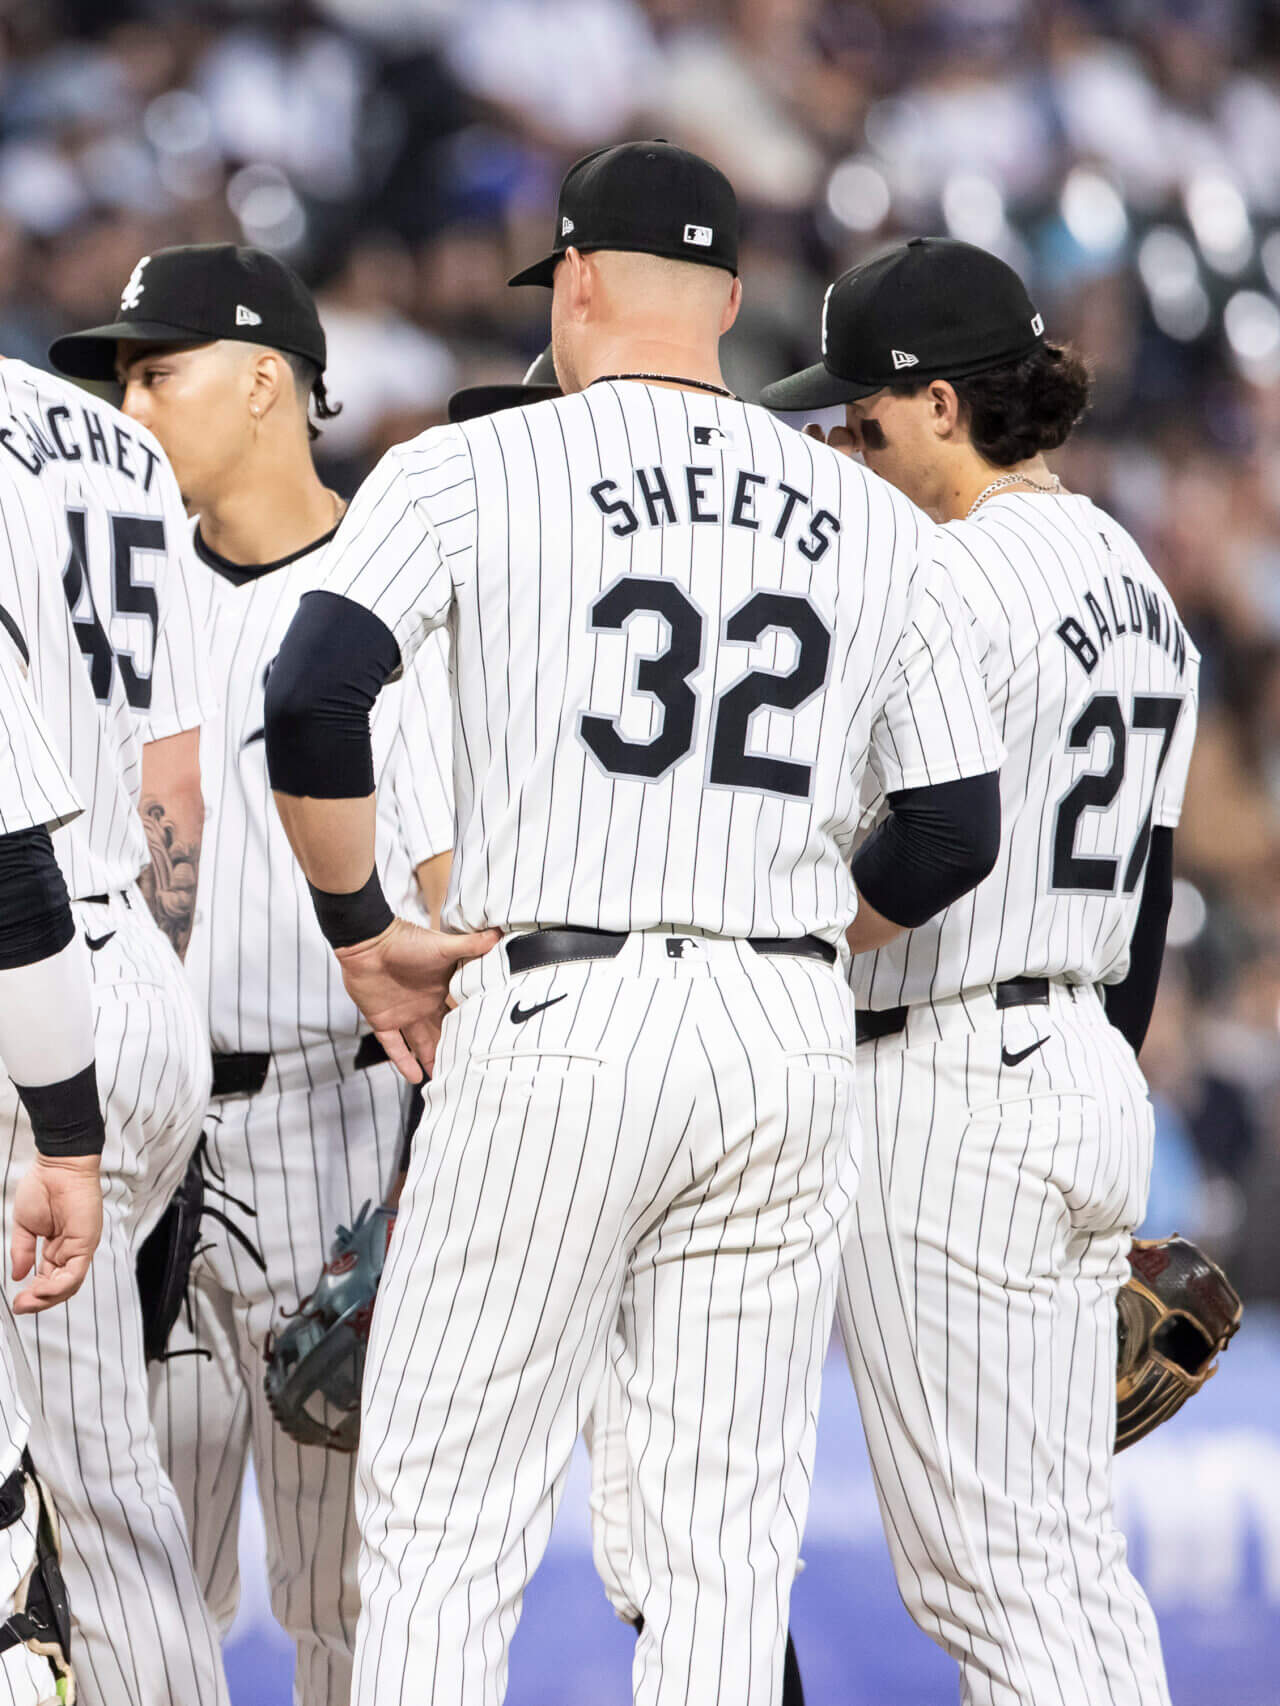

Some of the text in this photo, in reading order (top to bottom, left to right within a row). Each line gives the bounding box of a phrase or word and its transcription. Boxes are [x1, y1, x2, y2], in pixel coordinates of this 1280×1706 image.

[62, 504, 167, 714] 45
[589, 465, 842, 563] SHEETS
[575, 572, 835, 803] 32
[1055, 575, 1187, 678] BALDWIN
[1047, 691, 1187, 896] 27
